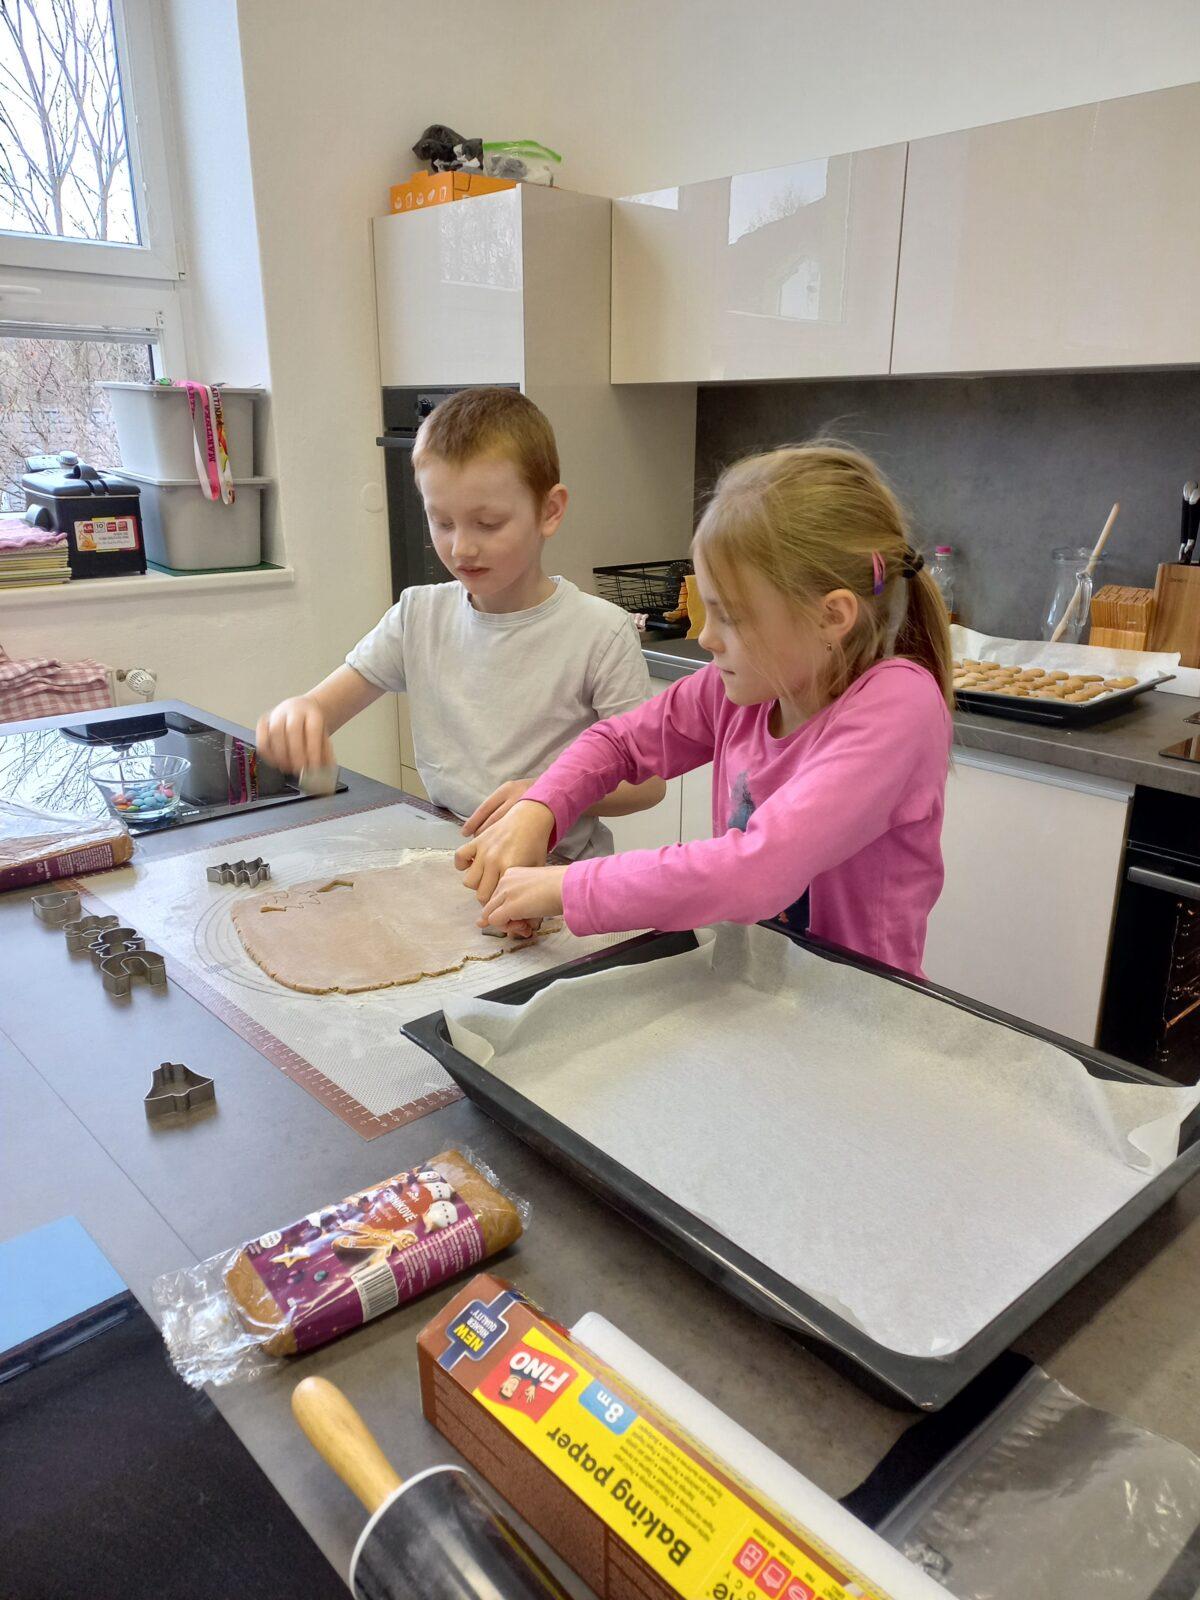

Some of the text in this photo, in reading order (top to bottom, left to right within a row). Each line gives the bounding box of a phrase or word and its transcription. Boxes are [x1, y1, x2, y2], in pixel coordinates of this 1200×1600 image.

[205, 405, 216, 462] MARTINKA
[453, 1323, 485, 1352] NEW
[466, 1318, 490, 1340] HIGHER
[509, 1351, 570, 1393] FINO
[546, 1427, 615, 1487] paper
[610, 1478, 692, 1567] Baking
